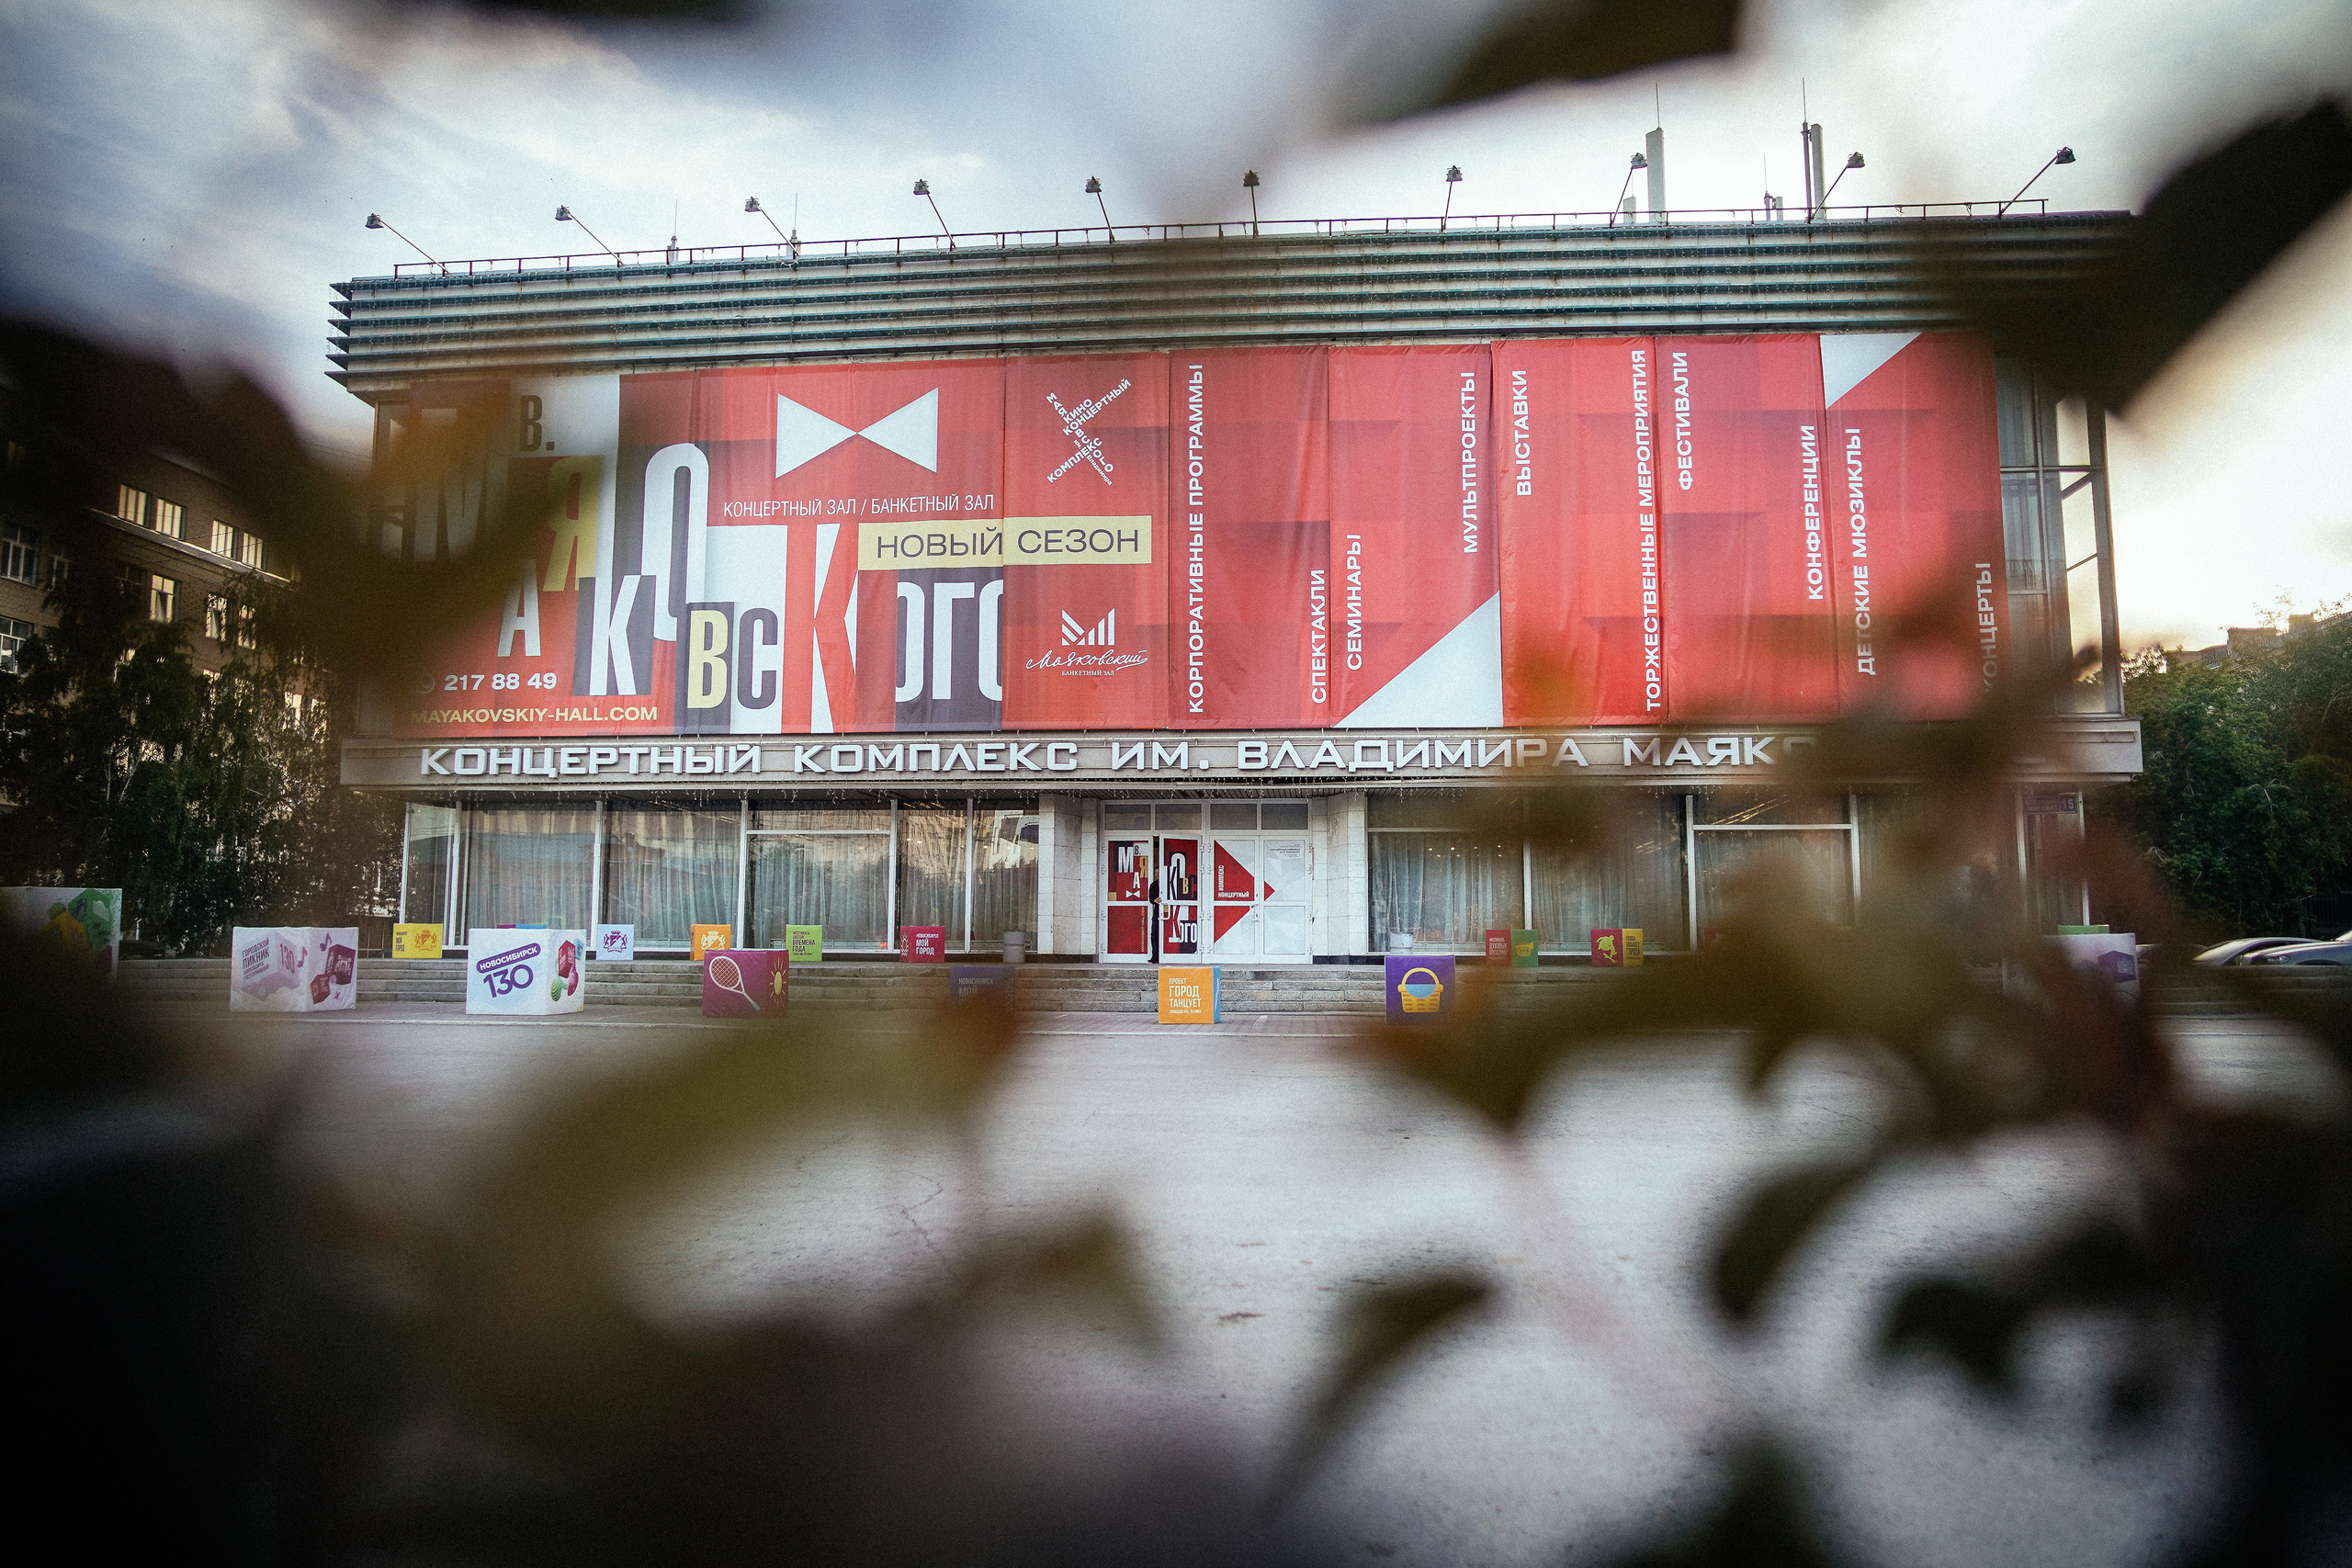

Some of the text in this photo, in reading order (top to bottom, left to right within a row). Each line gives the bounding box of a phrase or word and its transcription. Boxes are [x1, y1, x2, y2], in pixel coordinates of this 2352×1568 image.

[1062, 378, 1132, 435] КОНЦЕРТНЫЙ
[1063, 399, 1092, 424] КИНО
[1672, 352, 1693, 491] ФЕСТИВАЛИ
[519, 395, 555, 451] В.
[1511, 370, 1532, 496] ВЫСТАВКИ
[1046, 437, 1102, 483] КОМПЛЕКС
[1461, 371, 1478, 553] МУЛЬТПРОЕКТЫ
[724, 498, 821, 518] КОНЦЕРТНЫЙ
[826, 499, 856, 514] ЗАЛ
[871, 493, 959, 514] БАНКЕТНЫЙ
[965, 493, 994, 510] ЗАЛ
[1801, 425, 1824, 600] КОНФЕРЕНЦИИ
[876, 526, 1139, 558] НОВЫЙ СЕЗОН
[1189, 365, 1204, 713] КОРПОРАТИВНЫЕ ПРОГРАММЫ
[1631, 350, 1661, 711] ТОРЖЕСТВЕННЫЕ МЕРОПРИЯТИЯ
[1845, 428, 1876, 675] ДЕТСКИЕ МЮЗИКЛЫ
[1346, 535, 1363, 671] СЕМИНАРЫ
[1310, 570, 1326, 705] СПЕКТАКЛИ
[1025, 649, 1148, 671] Маяковский
[445, 672, 558, 691] 217 88 49
[413, 706, 658, 724] MAYAKOVSKIY-HALL.COM
[420, 743, 762, 778] КОНЦЕРТНЫЙ
[793, 740, 1078, 773] КОМПЛЕКС
[1111, 739, 1210, 772] ИМ.
[1237, 736, 1589, 773] ВЛАДИМИРА
[2062, 798, 2075, 809] 15
[243, 937, 269, 958] ГОРОДСКОЙ
[243, 947, 270, 969] ПИКНИК
[279, 942, 295, 974] 130
[480, 946, 538, 971] НОВОСИБИРСК
[916, 938, 929, 947] МОЙ
[916, 947, 934, 955] ГОРОД
[482, 964, 534, 998] 130
[1169, 986, 1200, 998] ГОРОД
[1169, 998, 1202, 1009] ТАНЦУЕТ
